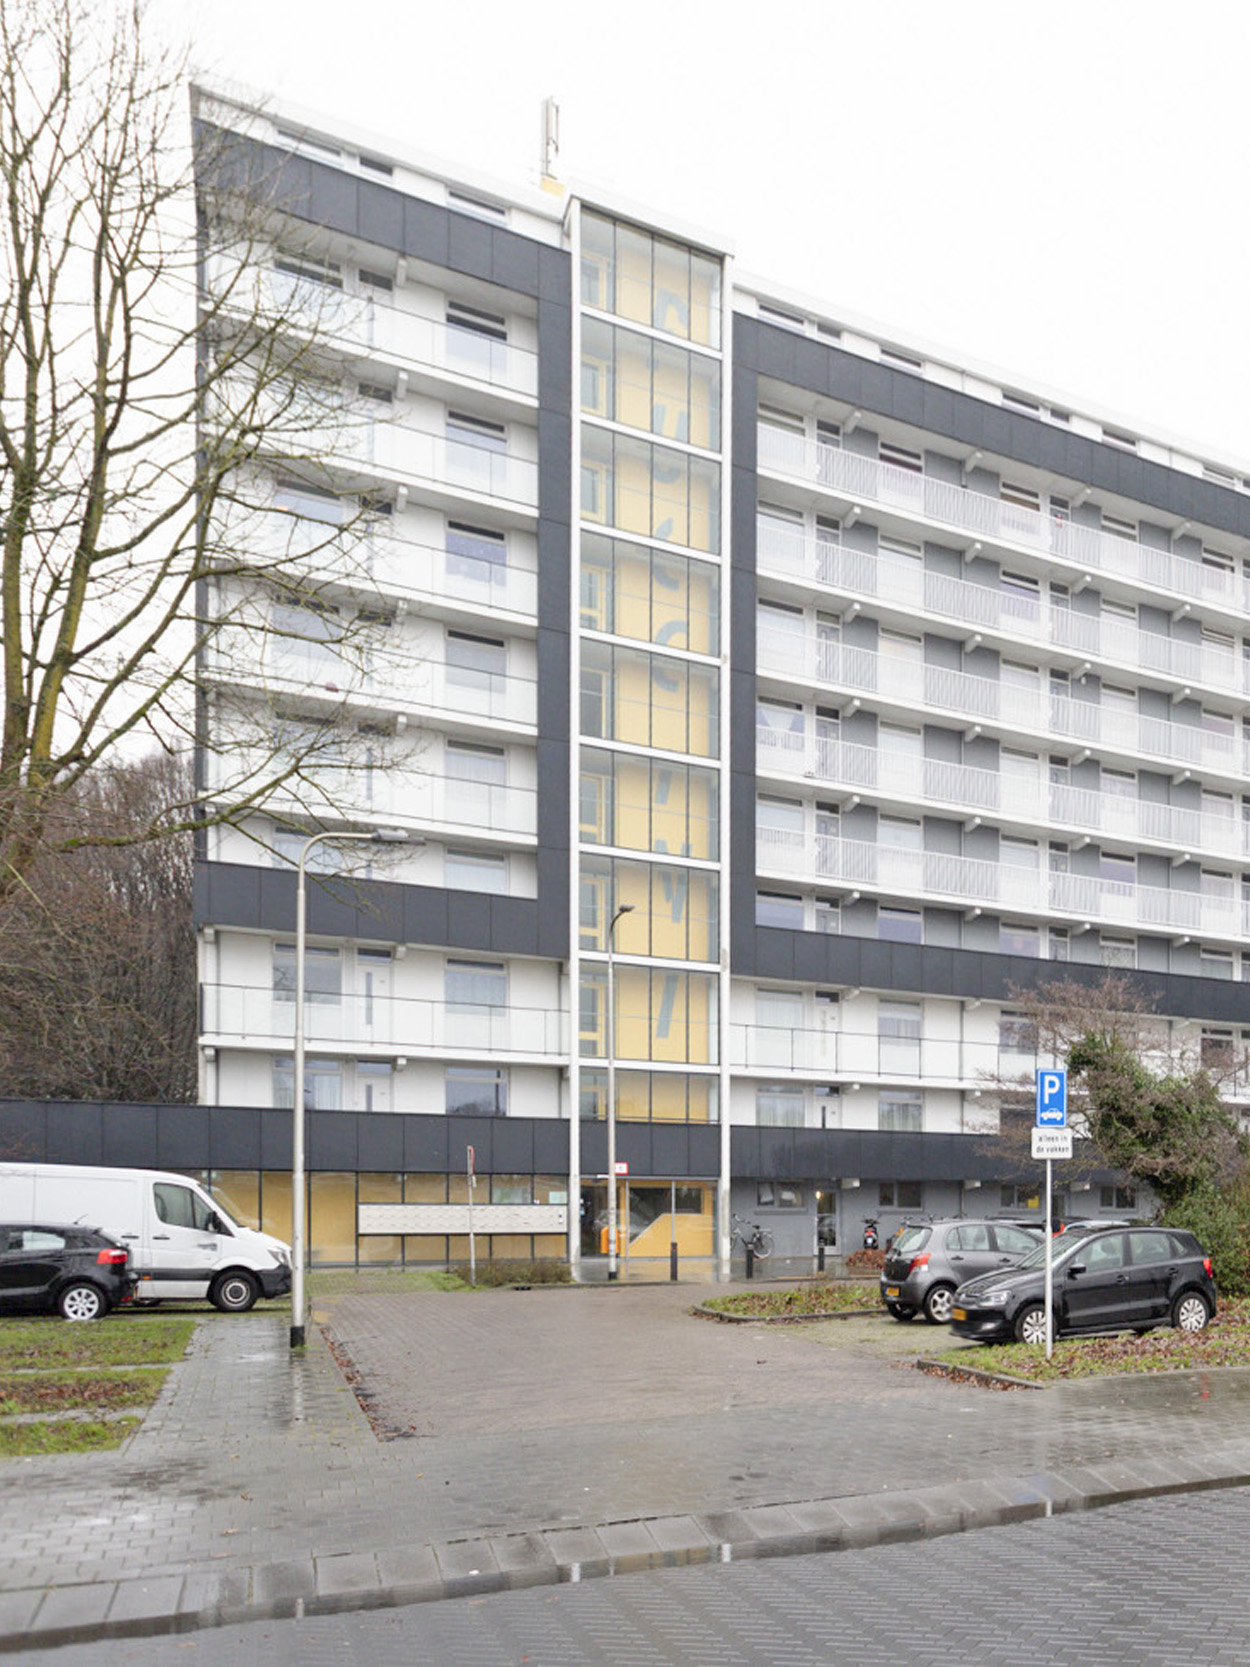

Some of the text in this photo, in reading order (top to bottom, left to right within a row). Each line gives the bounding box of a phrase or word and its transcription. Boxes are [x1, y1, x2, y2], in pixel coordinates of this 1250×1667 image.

[1044, 1075, 1060, 1104] P
[1036, 1145, 1070, 1153] de vakken
